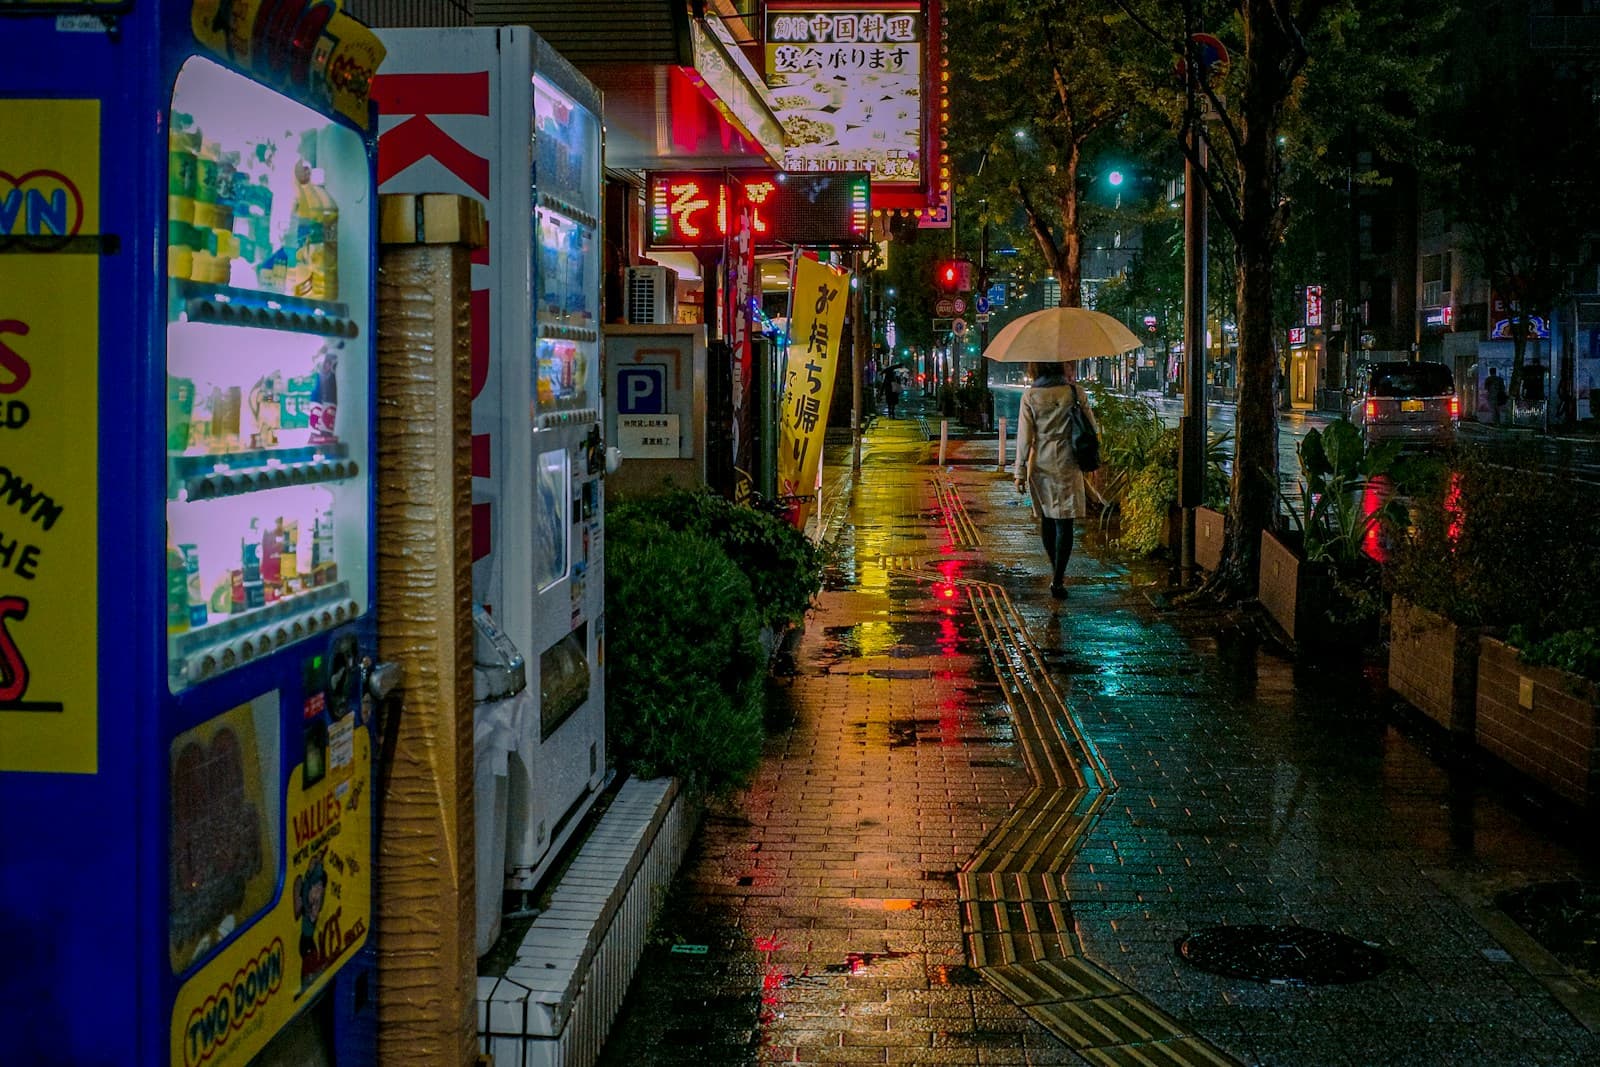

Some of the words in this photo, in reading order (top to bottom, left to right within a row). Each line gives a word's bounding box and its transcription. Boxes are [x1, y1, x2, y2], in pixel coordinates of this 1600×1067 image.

[777, 47, 910, 70] 宴会承ります
[627, 374, 654, 410] P
[792, 283, 838, 471] お持ち帰り
[293, 791, 341, 848] VALUES
[190, 997, 229, 1061] TWO
[235, 947, 281, 1018] DOWN
